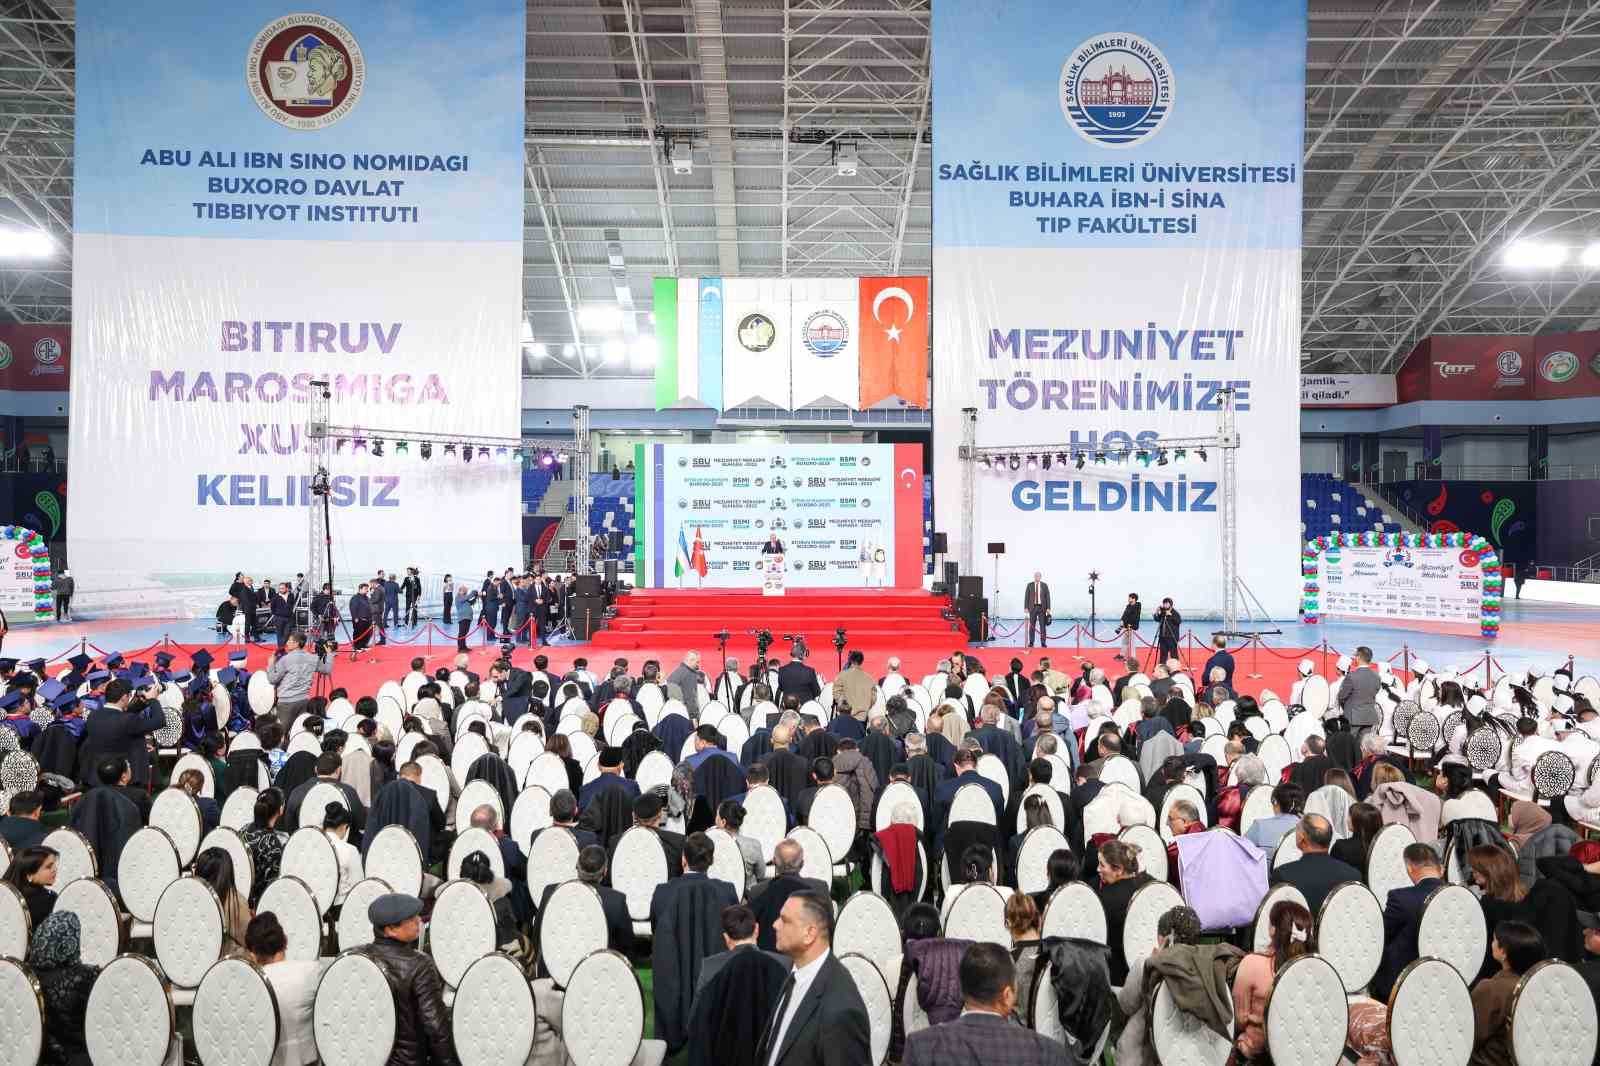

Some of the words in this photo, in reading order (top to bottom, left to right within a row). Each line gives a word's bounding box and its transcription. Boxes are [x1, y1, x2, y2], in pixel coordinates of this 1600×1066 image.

[288, 15, 327, 26] BUXORO
[1065, 63, 1080, 103] SAĞLIK
[1077, 37, 1128, 63] BİLİMLERİ
[1131, 40, 1170, 103] ÜNİVERSİTESİ
[140, 149, 191, 167] ABU
[198, 150, 236, 168] ALI
[244, 152, 283, 169] IBN
[290, 153, 346, 171] SINO
[353, 154, 468, 172] NOMIDAGI
[939, 161, 1020, 181] SAĞLIK
[1025, 163, 1135, 183] BİLİMLERİ
[1142, 163, 1296, 183] ÜNİVERSİTESİ
[208, 177, 308, 196] BUXORO
[314, 179, 404, 197] DAVLAT
[1009, 191, 1105, 208] BUHARA
[1111, 188, 1165, 208] İBN-İ
[1171, 188, 1226, 209] SİNA
[192, 202, 301, 222] TIBBIYOT
[307, 205, 418, 223] INSTITUTI
[1036, 216, 1071, 234] TIP
[1078, 214, 1197, 234] FAKÜLTESİ
[221, 320, 402, 354] BITIRUV
[988, 322, 1244, 361] MEZUNİYET
[978, 371, 1251, 412] TÖRENİMİZE
[1012, 473, 1217, 512] GELDİNİZ
